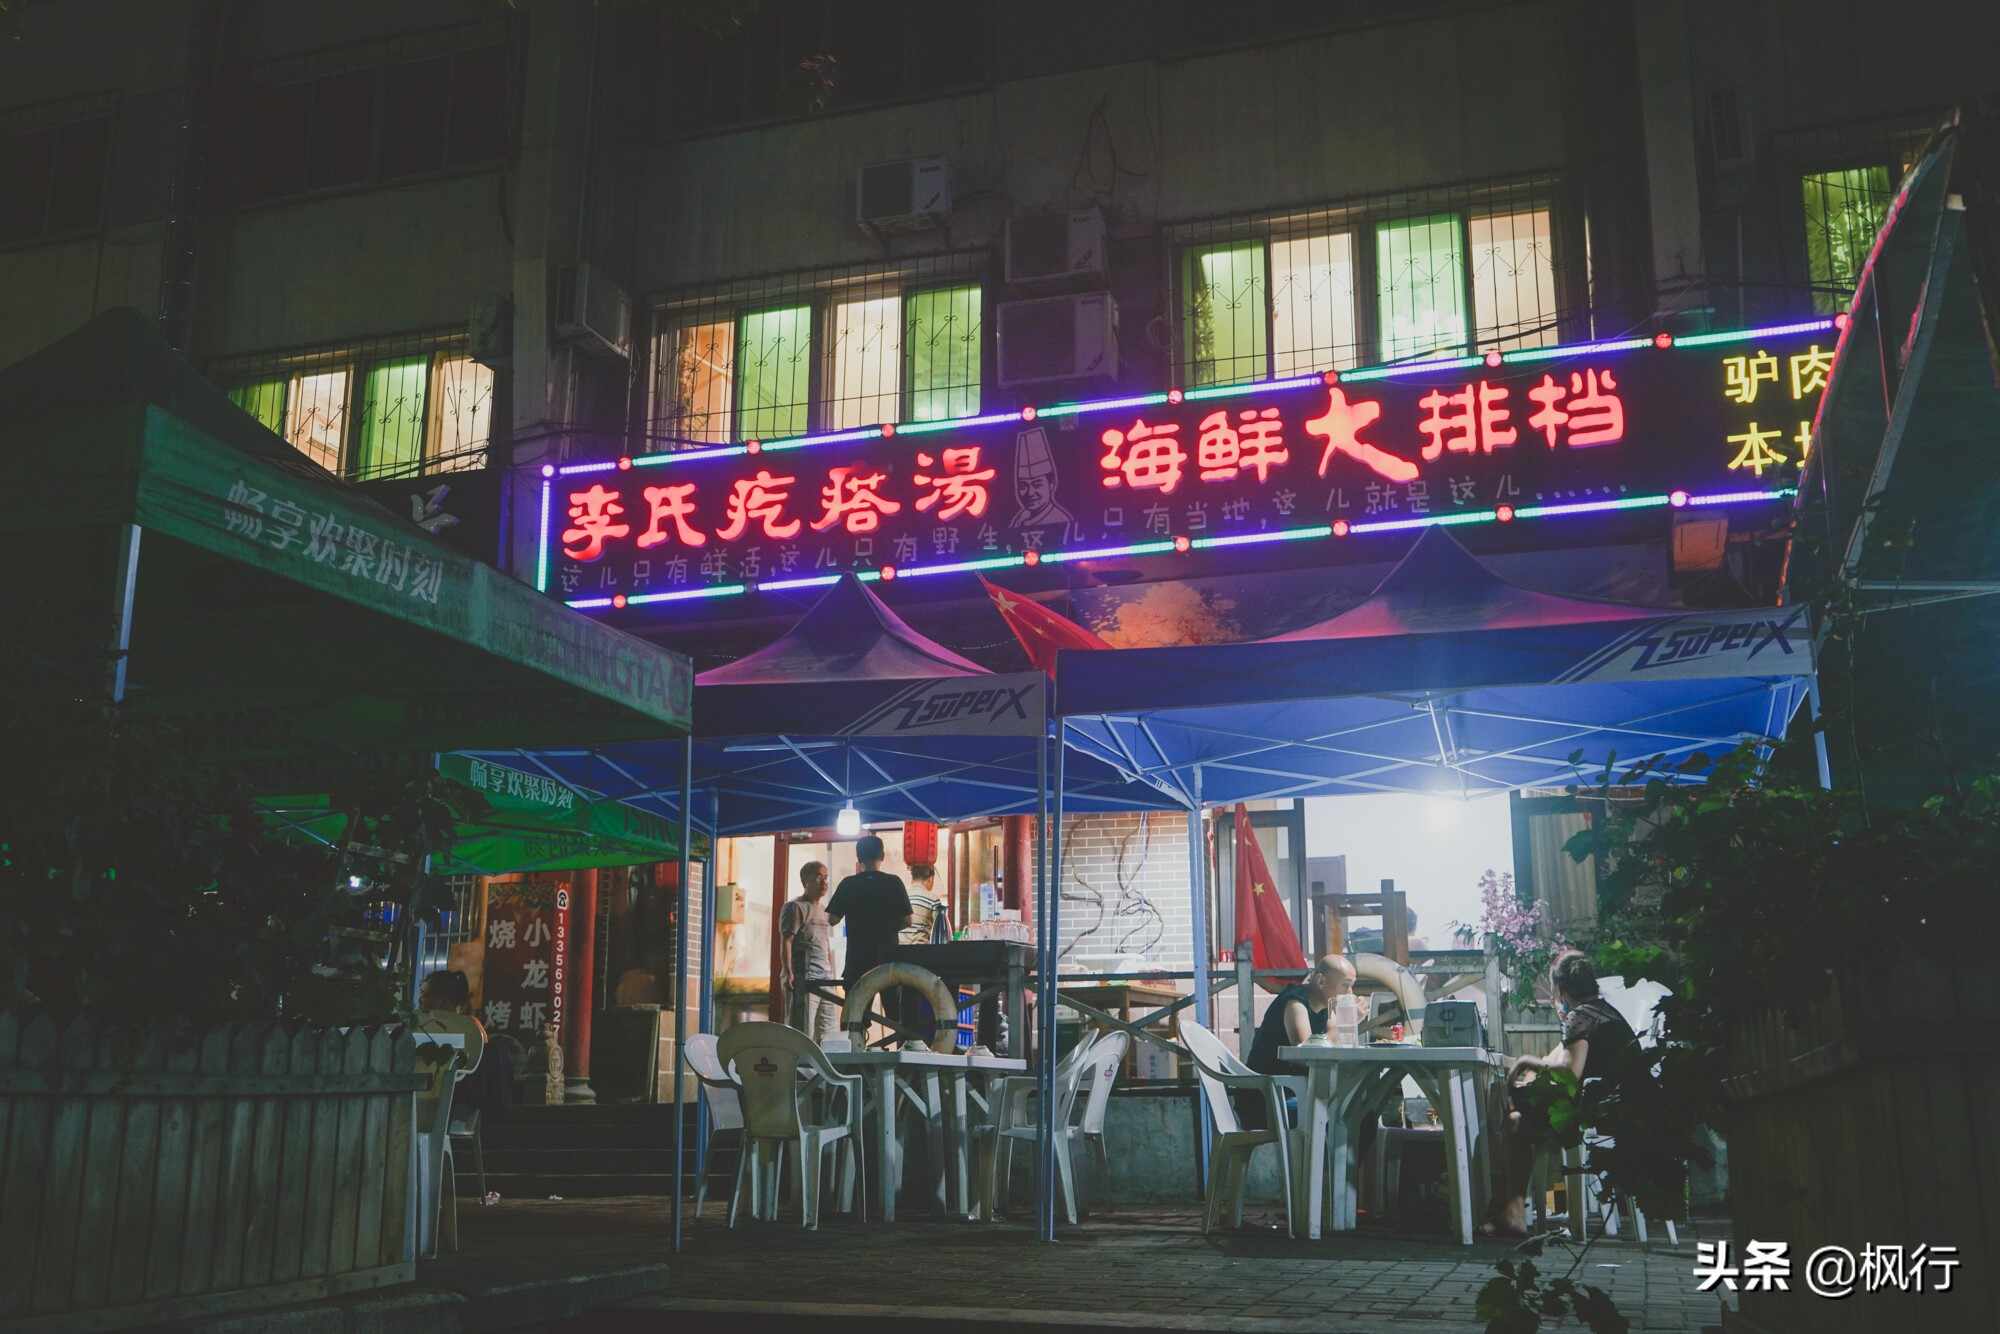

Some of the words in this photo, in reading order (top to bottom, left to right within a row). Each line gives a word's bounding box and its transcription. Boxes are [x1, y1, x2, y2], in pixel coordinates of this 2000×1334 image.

[1723, 345, 1836, 404] 驴肉
[1100, 368, 1625, 494] 海鲜大排档
[224, 480, 444, 604] 畅享欢聚时刻
[470, 759, 576, 809] 畅享欢聚时刻
[484, 919, 516, 1030] 烧烤
[520, 917, 552, 1031] 小龙虾
